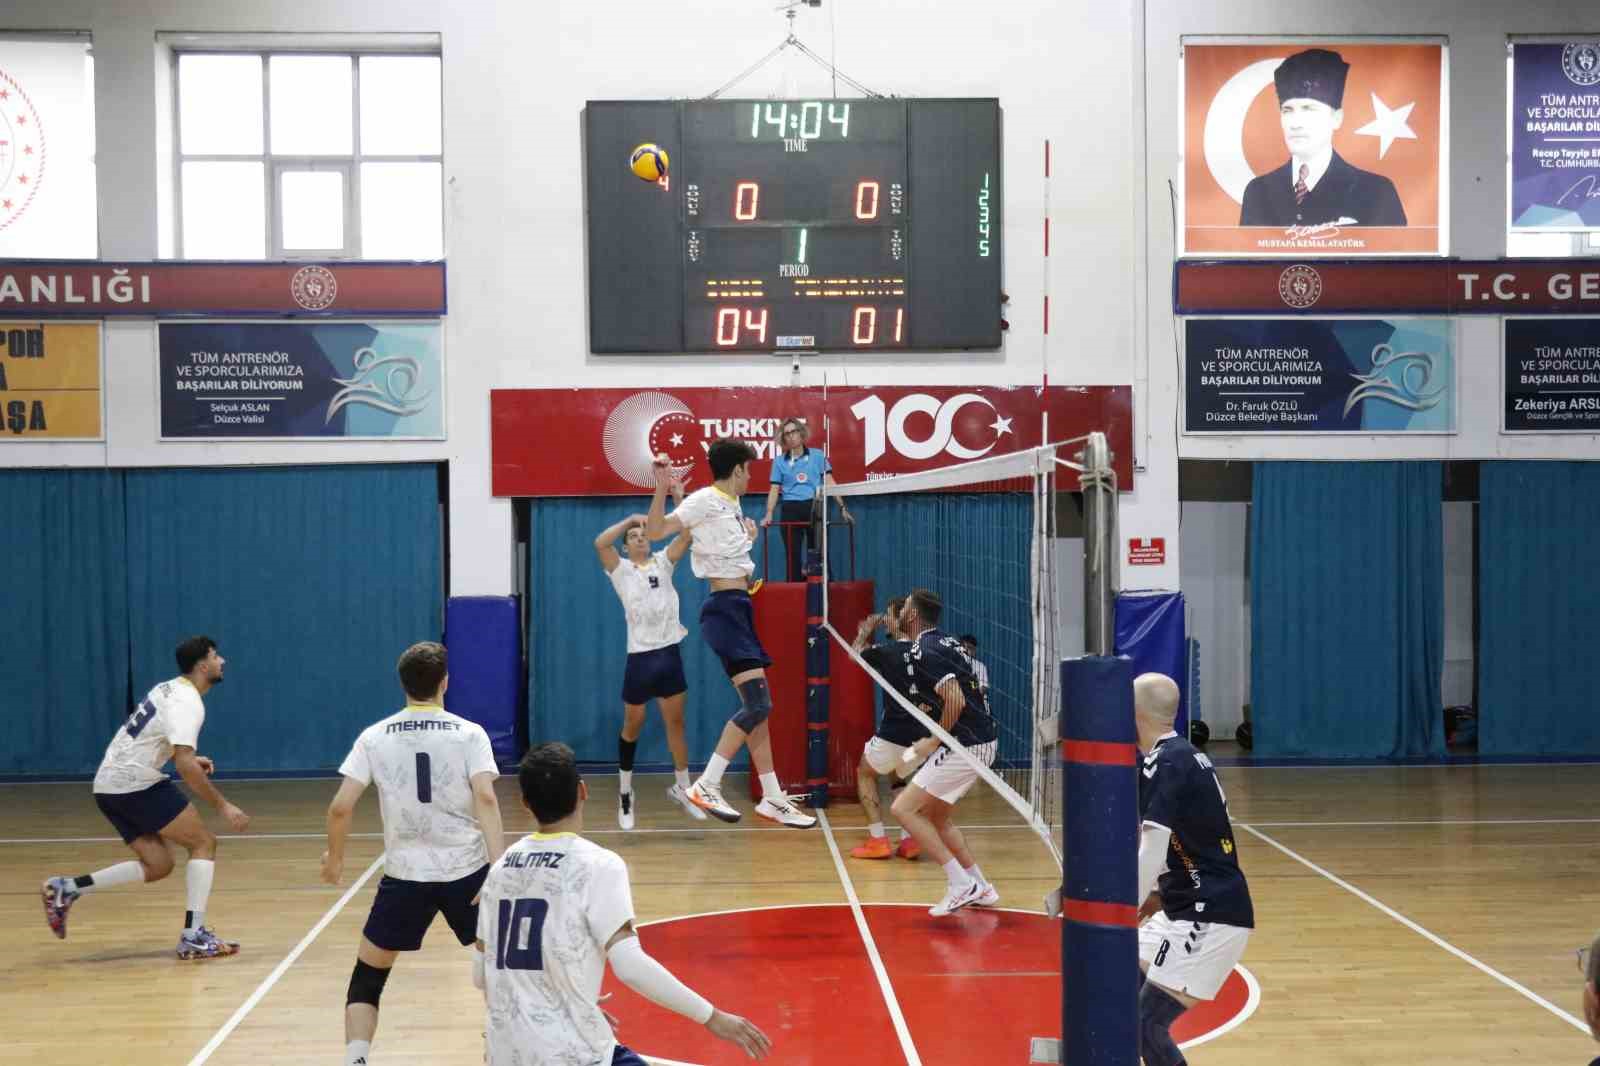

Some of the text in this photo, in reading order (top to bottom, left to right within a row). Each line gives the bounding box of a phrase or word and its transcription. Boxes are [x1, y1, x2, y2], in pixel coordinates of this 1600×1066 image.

[1540, 94, 1600, 106] TÜM ANTR
[1527, 108, 1541, 118] VE
[752, 102, 850, 138] 14:04
[1526, 121, 1584, 133] BAŞARILAR
[783, 138, 808, 152] TIME
[1532, 149, 1560, 159] Recep
[735, 183, 759, 220] 0
[855, 182, 879, 219] 0
[779, 263, 810, 278] PERIOD
[0, 268, 150, 303] ANLIĞI
[1457, 273, 1600, 300] T.C. GE
[717, 308, 768, 346] 04
[853, 307, 903, 344] 01
[190, 351, 289, 363] TÜM ANTRENÖR
[1215, 346, 1309, 359] TÜM ANTRENÖR
[1535, 346, 1561, 358] TÜM
[176, 365, 192, 376] VE
[1201, 361, 1216, 372] VE
[1520, 360, 1535, 370] VE
[176, 379, 304, 391] BAŞARILAR DİLİYORUM
[1200, 374, 1322, 387] BAŞARILAR DİLİYORUM
[1520, 375, 1580, 386] BAŞARILAR
[240, 403, 270, 412] ASLAN
[1226, 400, 1298, 411] Dr. Faruk ÖZLÜ
[1514, 398, 1567, 413] Zekeriya
[242, 414, 265, 424] Valisi
[1205, 411, 1318, 423] Düzce Belediye Başkanı
[648, 576, 660, 588] 9
[386, 720, 461, 734] MEHMET
[415, 752, 432, 803] 1
[503, 851, 566, 869] YILMAZ
[496, 898, 549, 971] 10
[1154, 939, 1170, 967] 8
